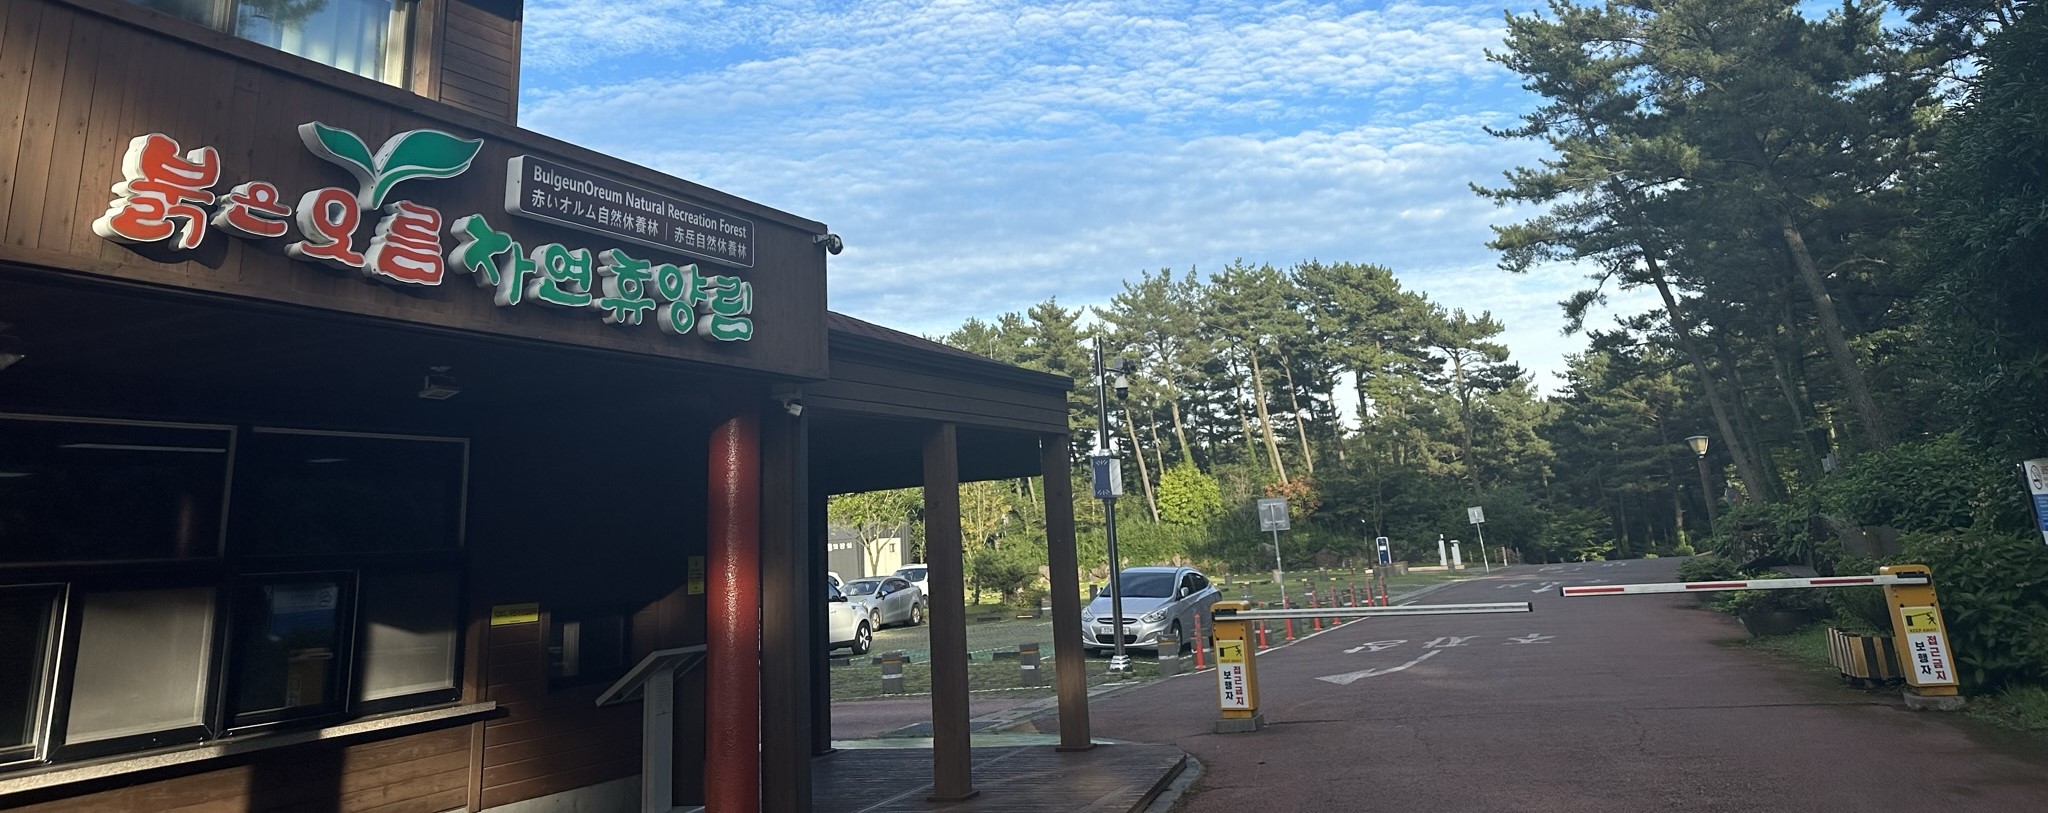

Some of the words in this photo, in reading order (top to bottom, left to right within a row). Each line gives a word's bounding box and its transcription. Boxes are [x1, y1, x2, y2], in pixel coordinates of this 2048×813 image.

[531, 189, 659, 237] 赤いオルム自然休養林
[533, 165, 622, 204] BulgeunOreum
[625, 191, 665, 216] Natural
[668, 203, 717, 230] Recreation
[719, 219, 747, 239] Forest
[674, 226, 747, 259] 赤岳自然休養林
[452, 214, 753, 342] 자연휴양림
[1915, 641, 1932, 675] 보행자
[1926, 635, 1947, 680] 접근금지
[1223, 670, 1234, 701] 보행자
[1233, 665, 1244, 706] 접근금지
